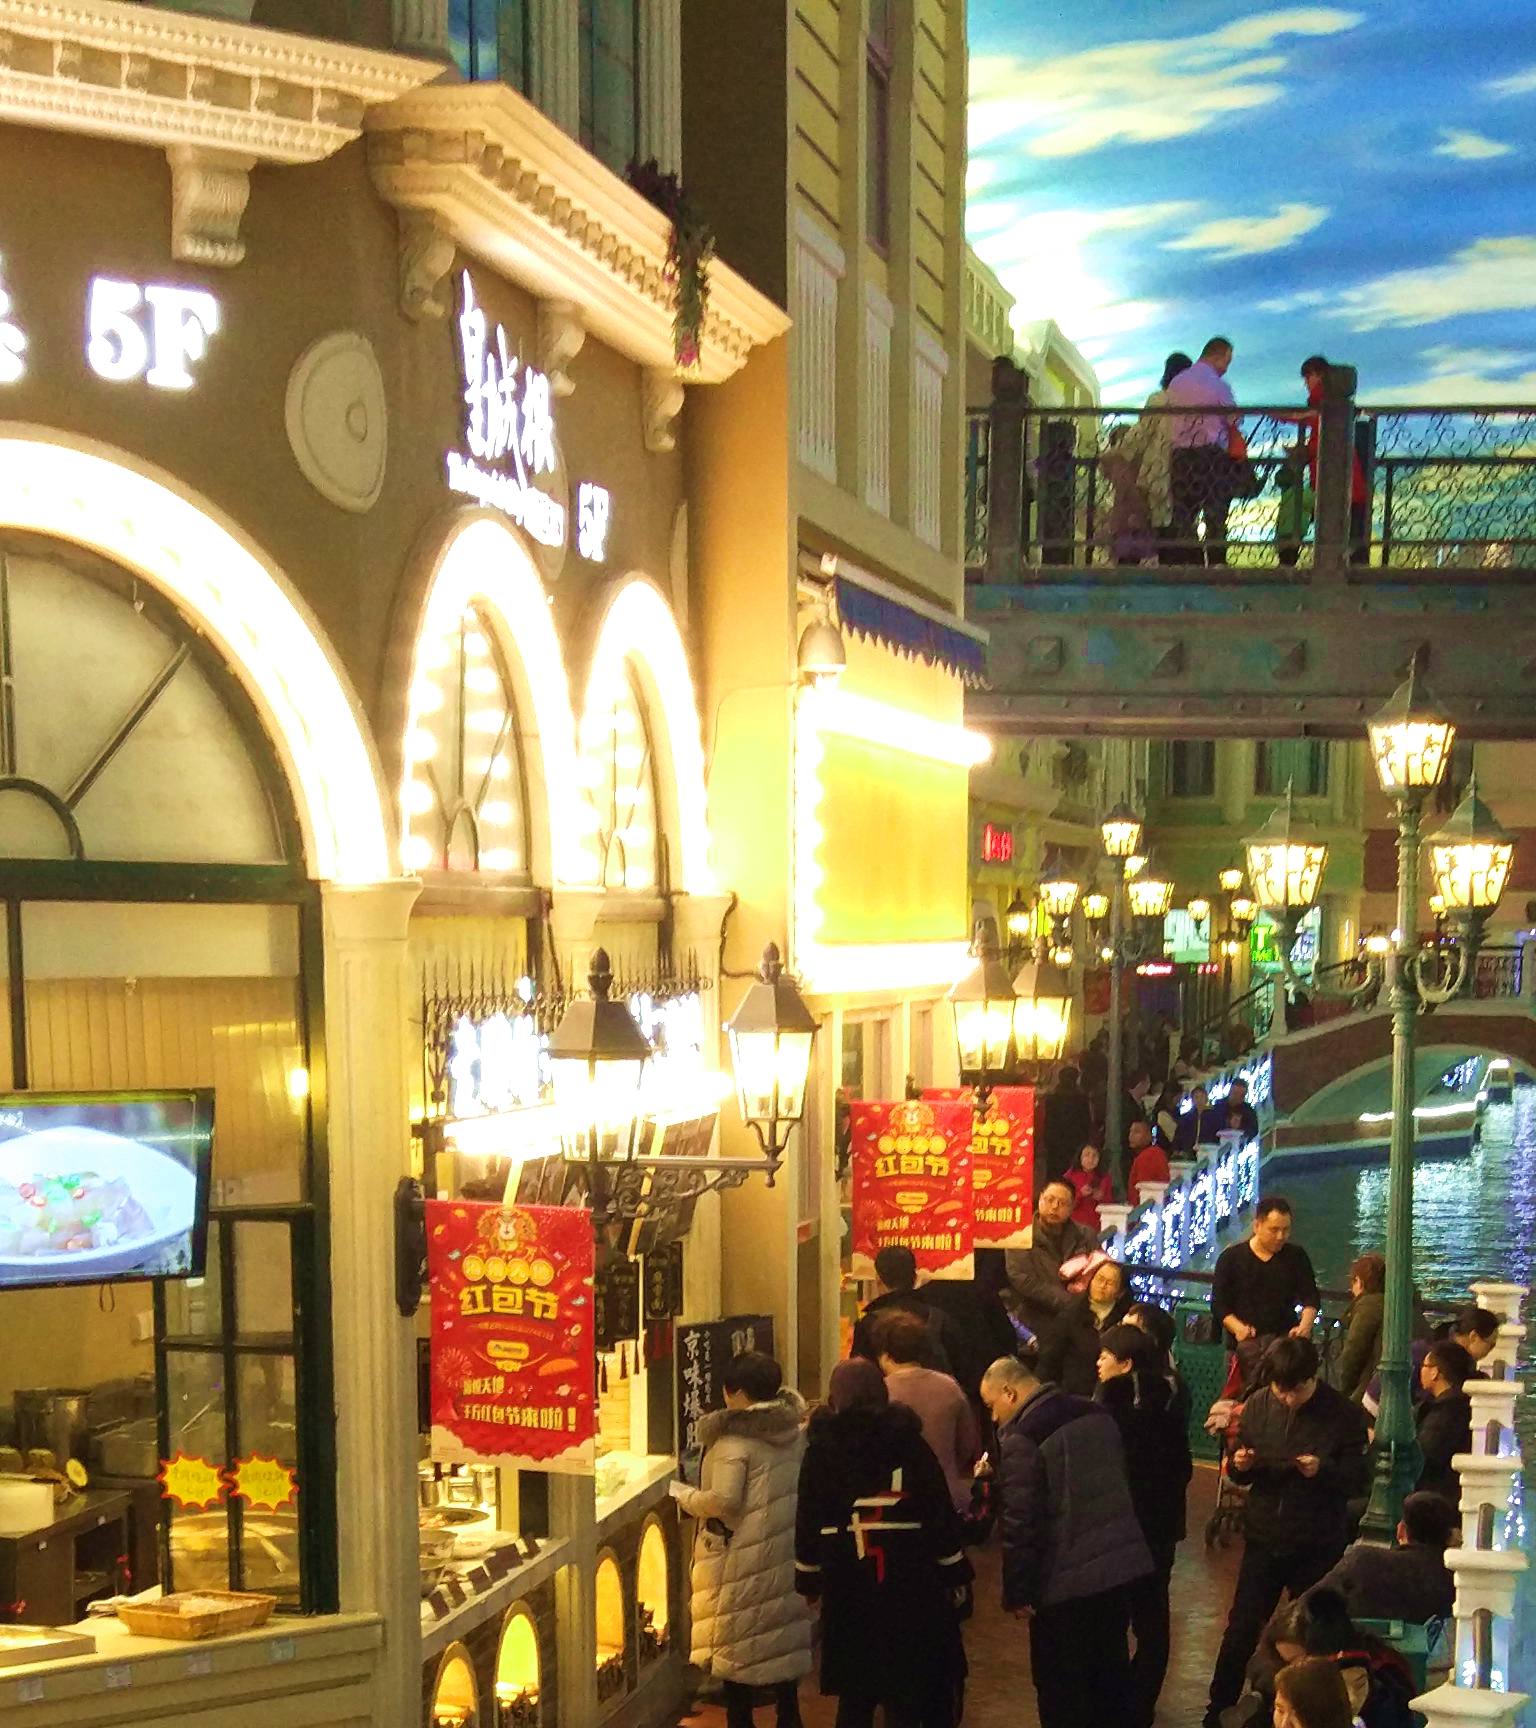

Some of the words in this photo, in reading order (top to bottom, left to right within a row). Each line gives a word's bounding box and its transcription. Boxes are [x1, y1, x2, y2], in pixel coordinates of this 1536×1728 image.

[88, 278, 220, 390] 5F
[578, 482, 610, 562] 5F
[875, 1155, 949, 1178] 红包节
[459, 1285, 560, 1321] 红包节
